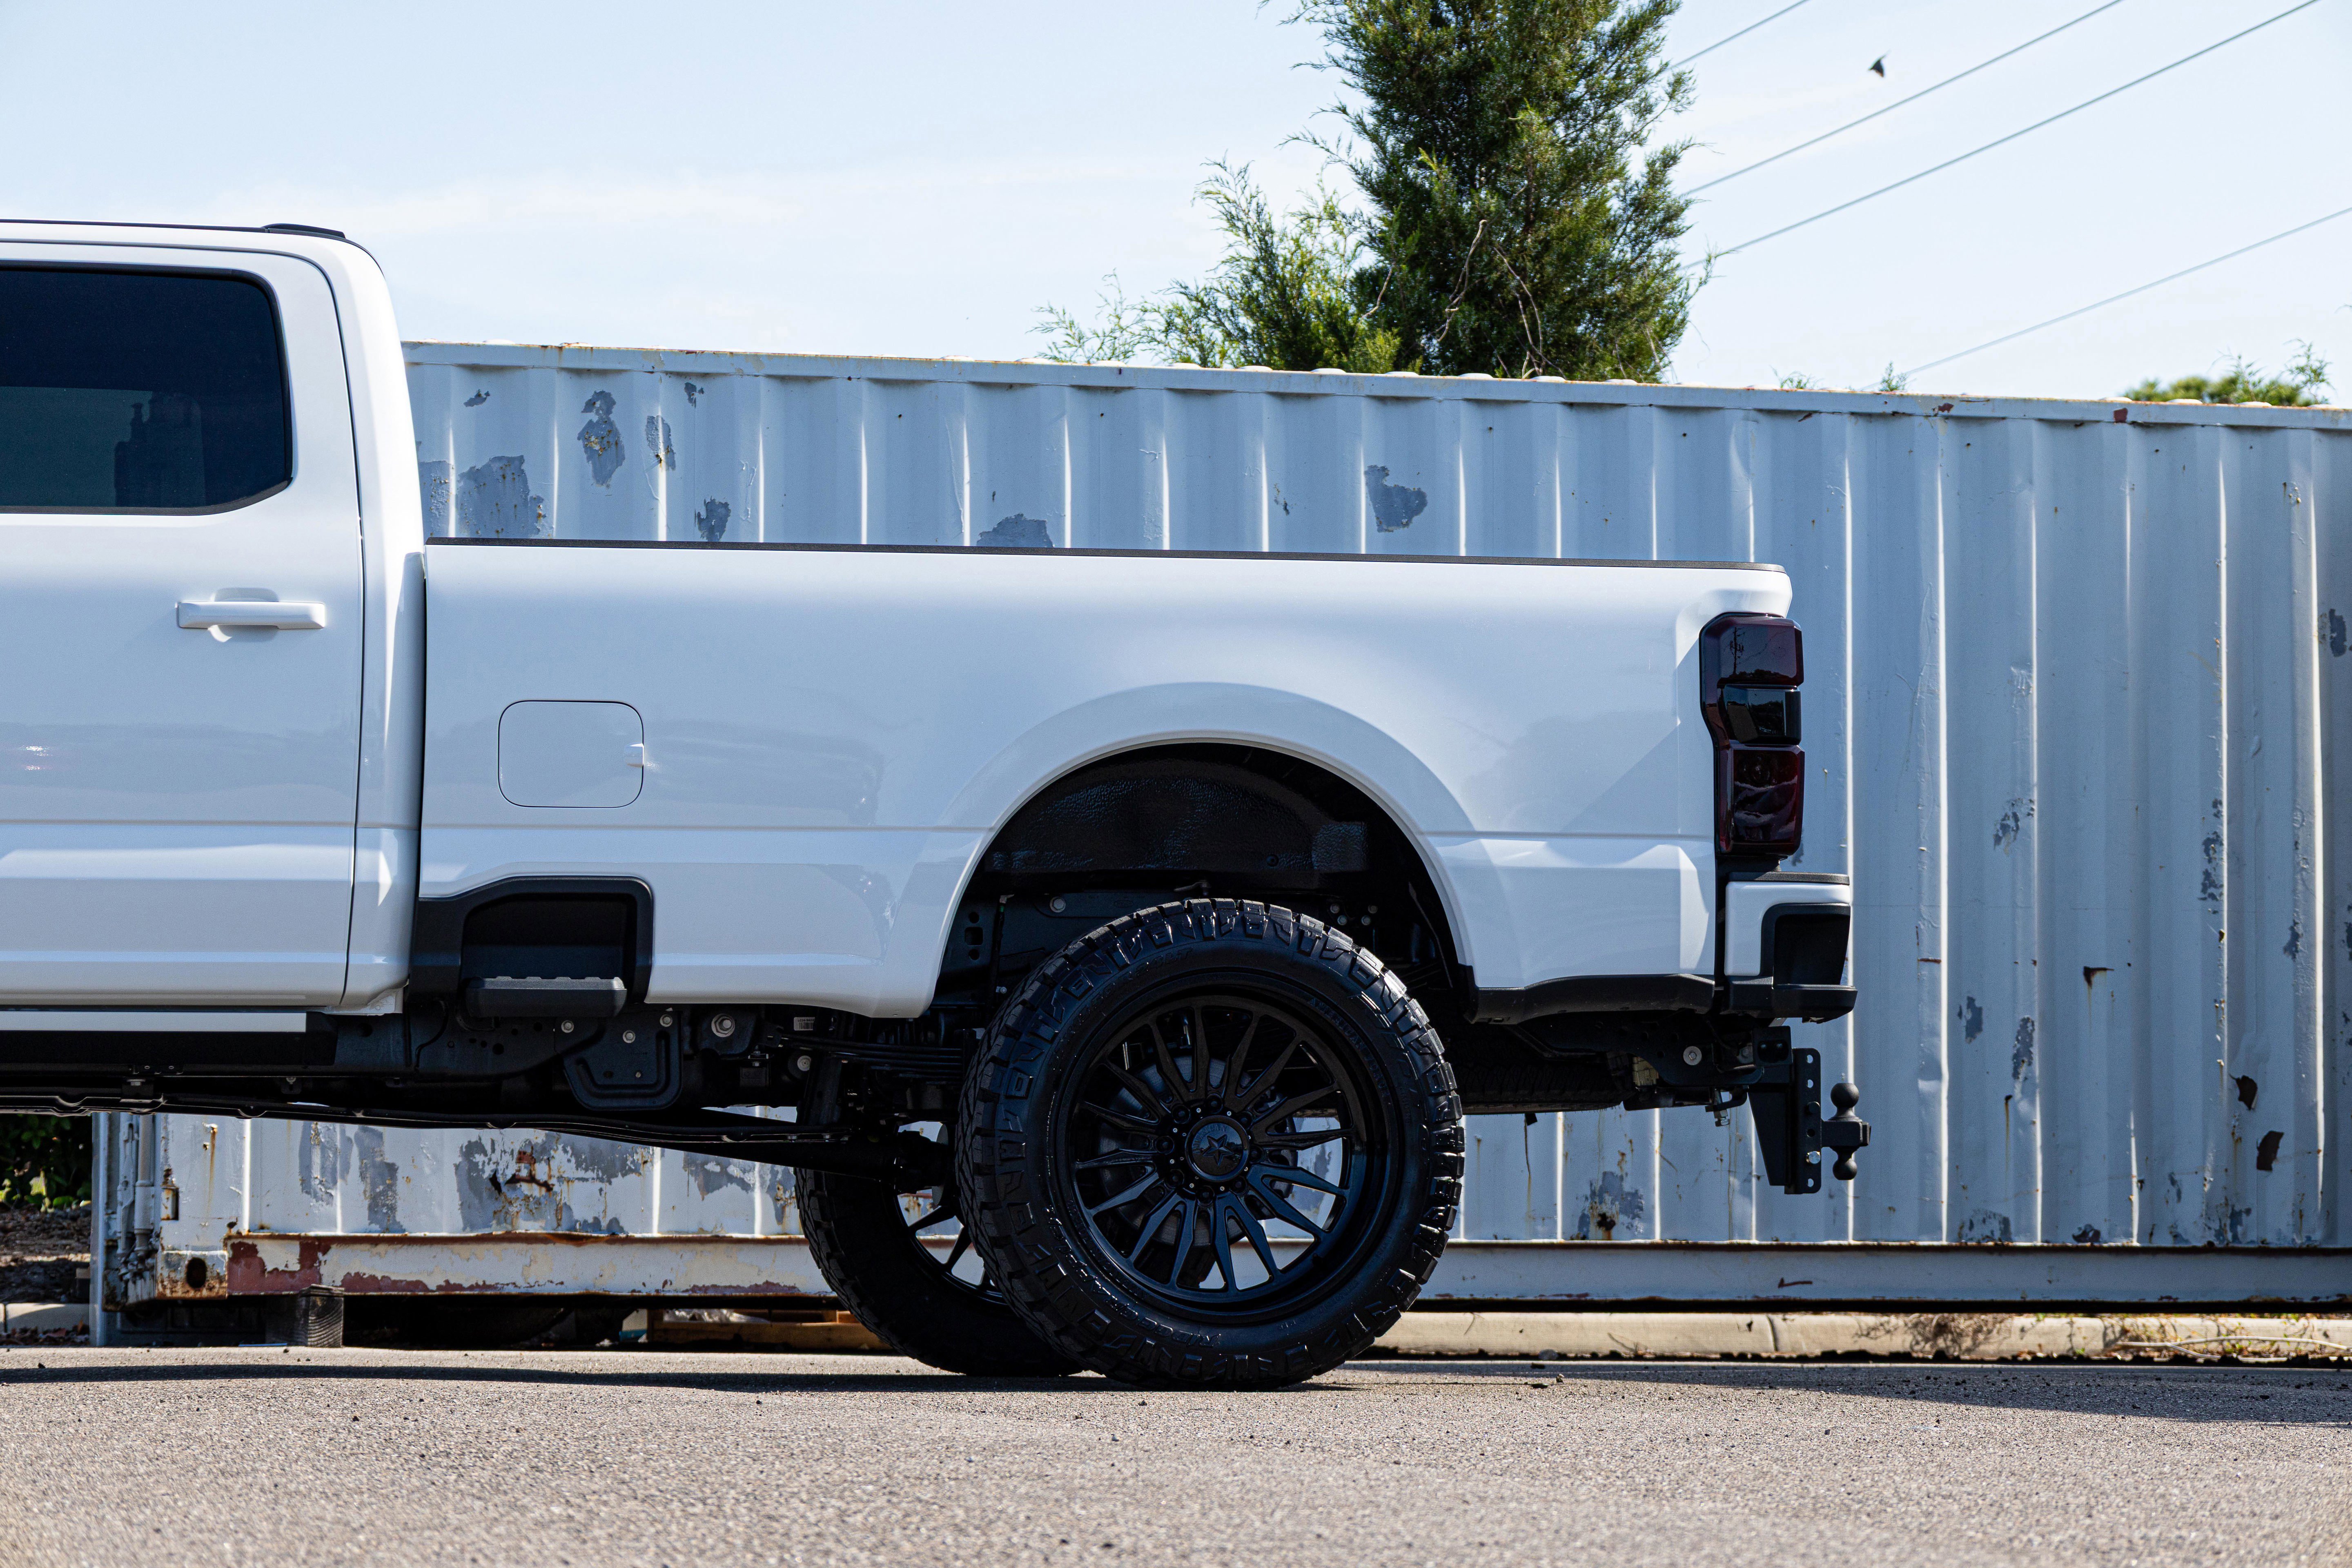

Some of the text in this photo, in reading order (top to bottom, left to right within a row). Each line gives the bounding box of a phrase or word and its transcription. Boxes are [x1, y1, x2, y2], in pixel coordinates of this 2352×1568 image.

[1310, 998, 1365, 1050] AMERICAN
[1045, 1205, 1221, 1348] RIDGE GRAPPLER
